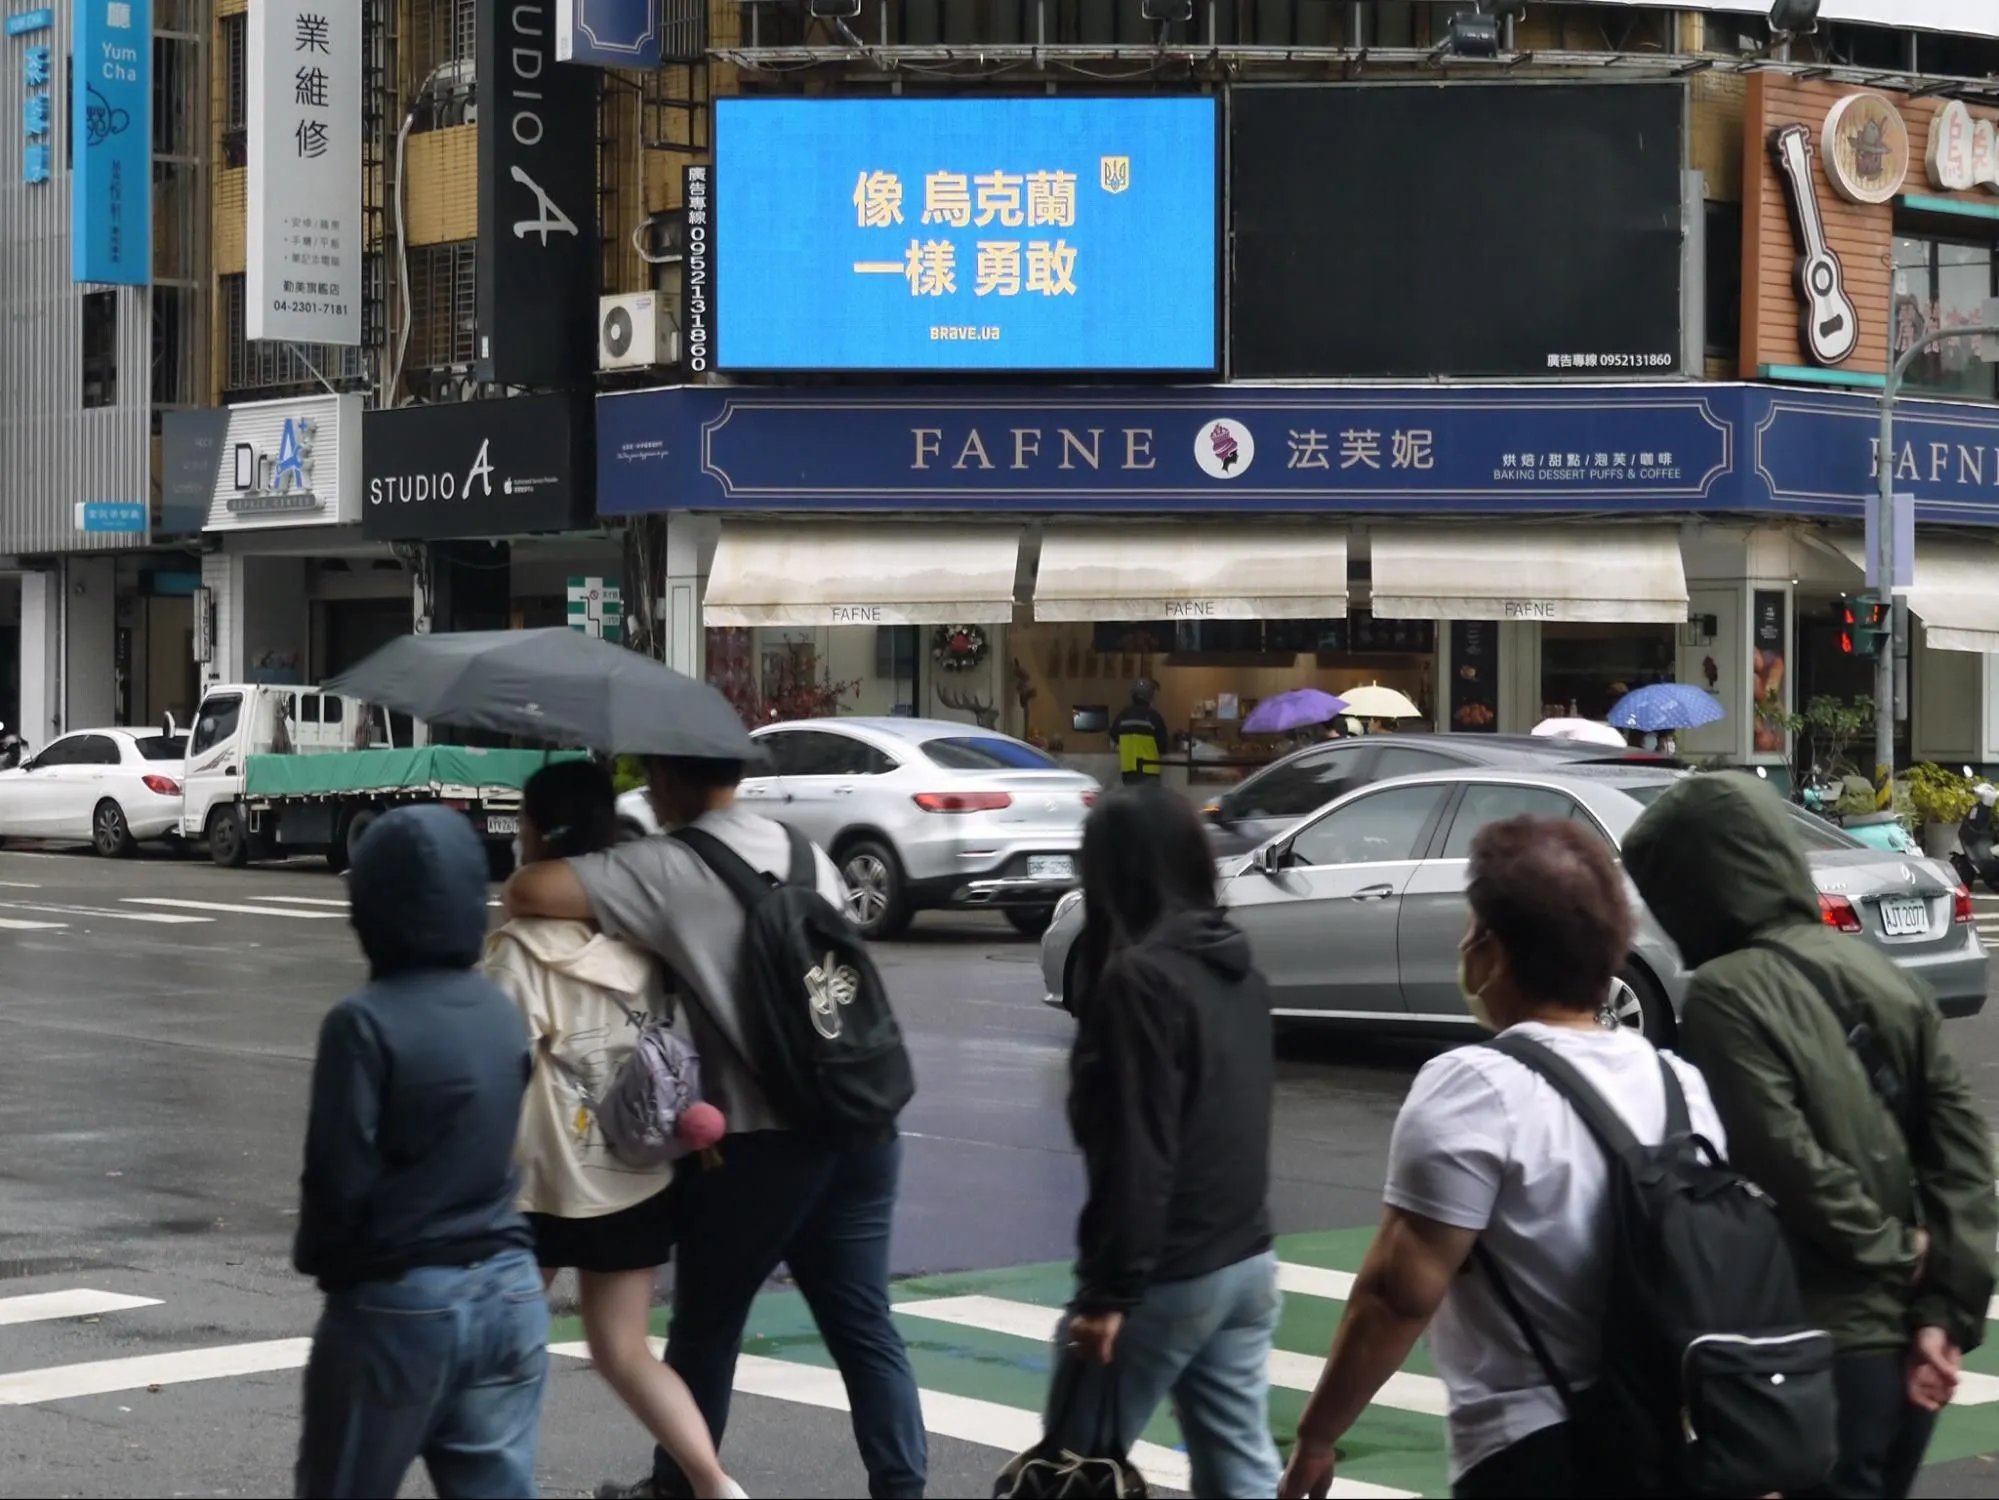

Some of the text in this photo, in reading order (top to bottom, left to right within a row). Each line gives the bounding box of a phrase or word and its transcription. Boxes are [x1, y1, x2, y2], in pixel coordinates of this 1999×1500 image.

[102, 41, 137, 61] Yum
[103, 62, 137, 82] Cha
[296, 13, 331, 158] 業維修
[510, 165, 579, 247] A
[853, 170, 1078, 228] 像 烏克蘭
[853, 239, 1079, 297] 一樣 勇敢
[273, 300, 348, 315] 04-2301-7181
[689, 227, 707, 372] 0952131860
[1600, 353, 1672, 367] 0952131860
[910, 428, 1157, 470] FAFNE
[1287, 428, 1434, 470] 法芙妮
[370, 437, 495, 505] STUDIO A
[1493, 467, 1681, 481] BAKING DESSERT PUFFS & COFFEE
[831, 605, 881, 622] FAFNE
[1165, 600, 1215, 616] FAFNE
[1504, 601, 1555, 617] FAFNE
